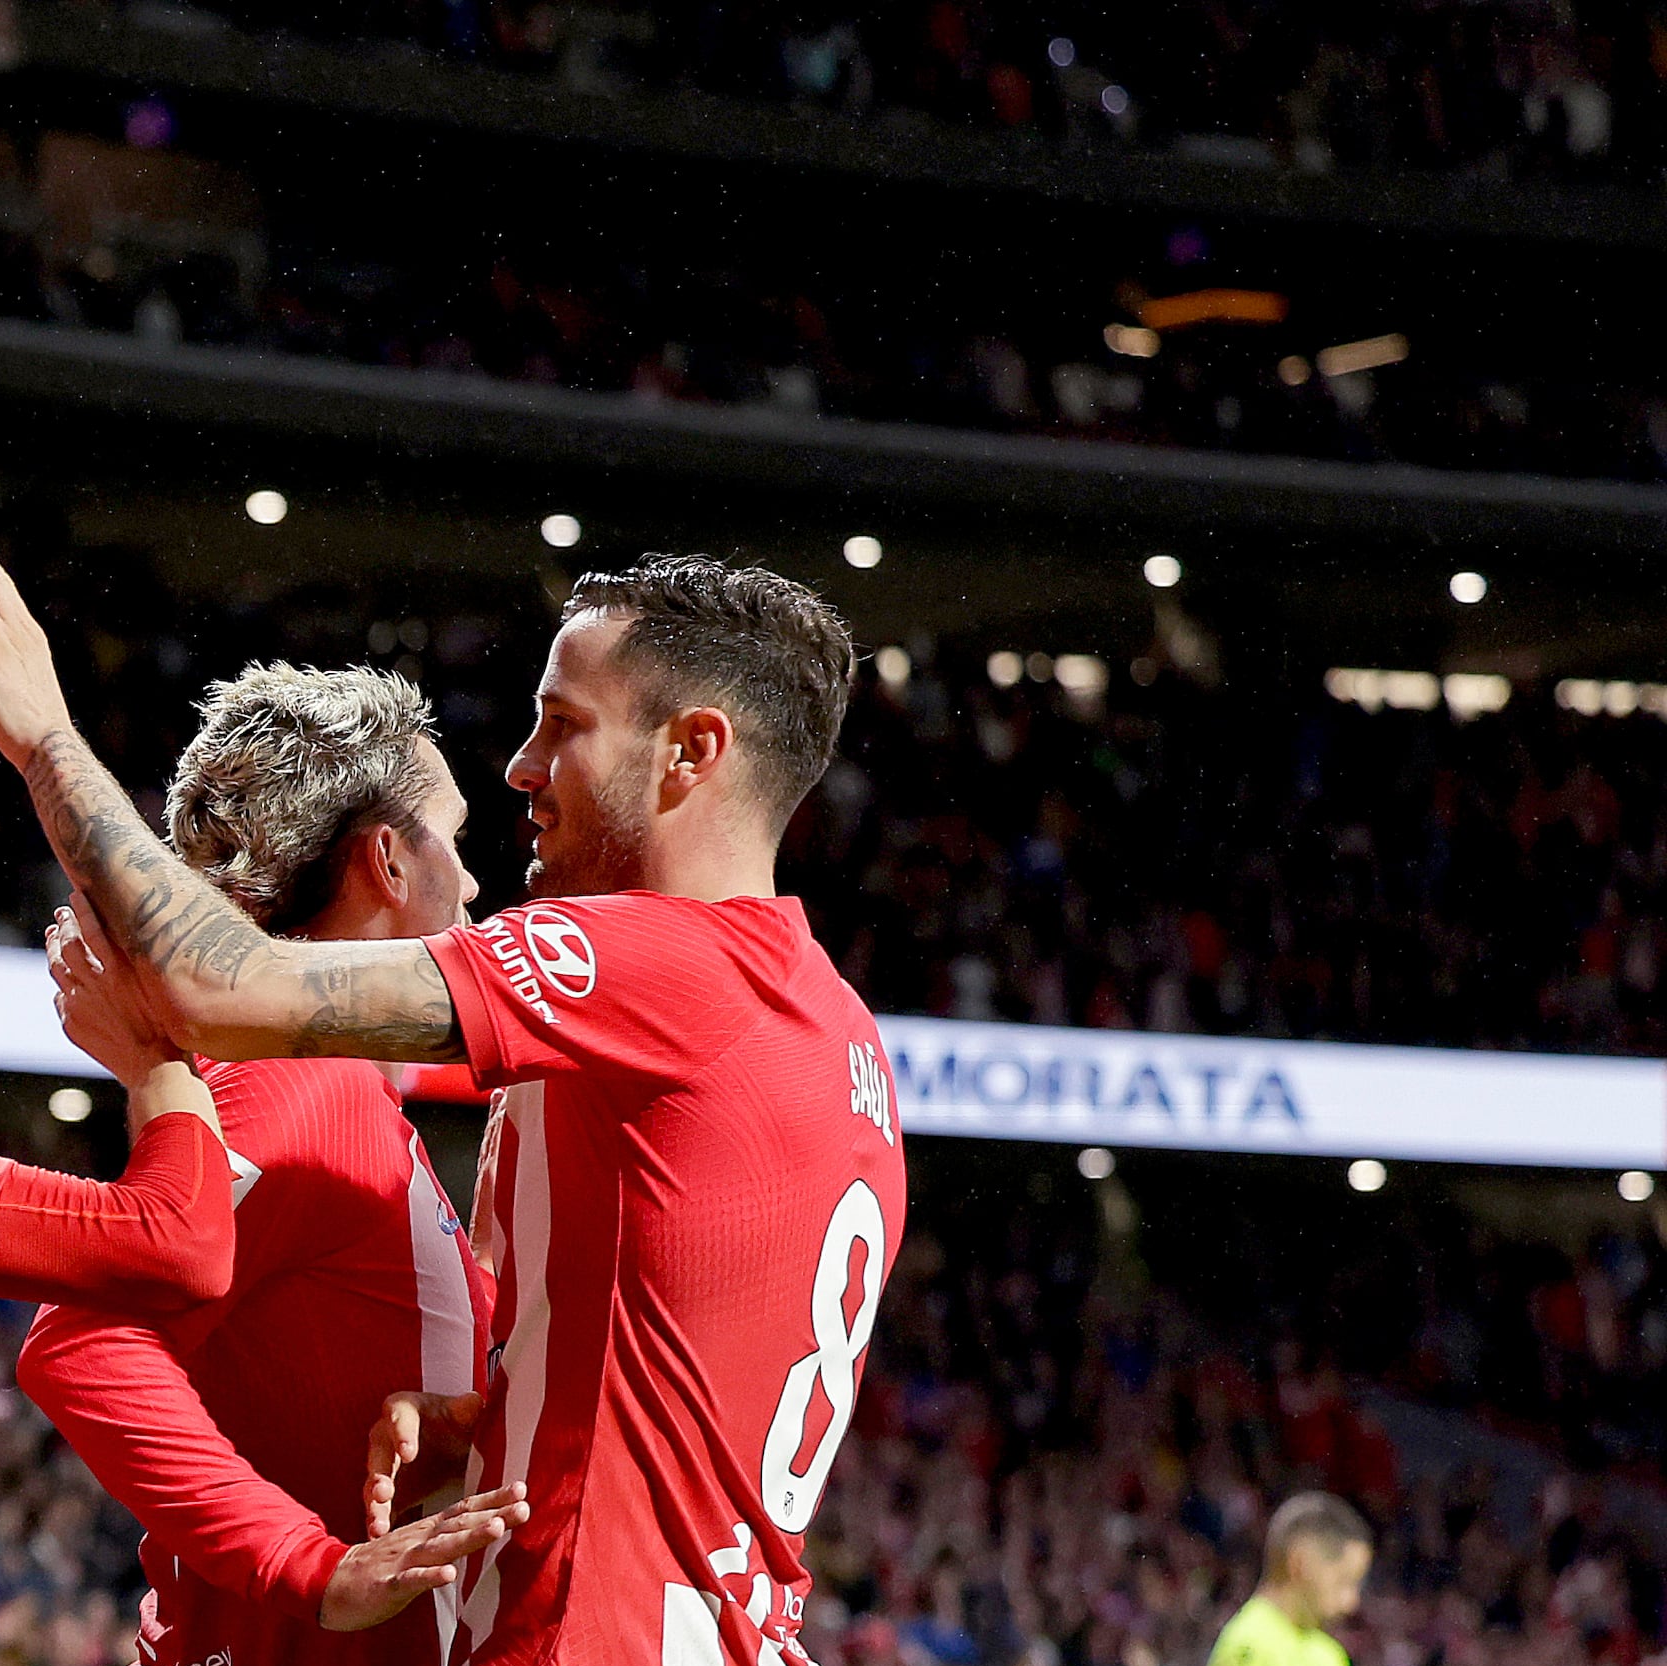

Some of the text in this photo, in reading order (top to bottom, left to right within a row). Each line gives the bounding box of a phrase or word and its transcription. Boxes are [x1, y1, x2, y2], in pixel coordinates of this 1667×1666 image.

[475, 917, 562, 1025] YUNDA
[848, 1040, 895, 1148] SAÚL
[895, 1048, 1311, 1123] MORATA
[760, 1178, 885, 1535] 8
